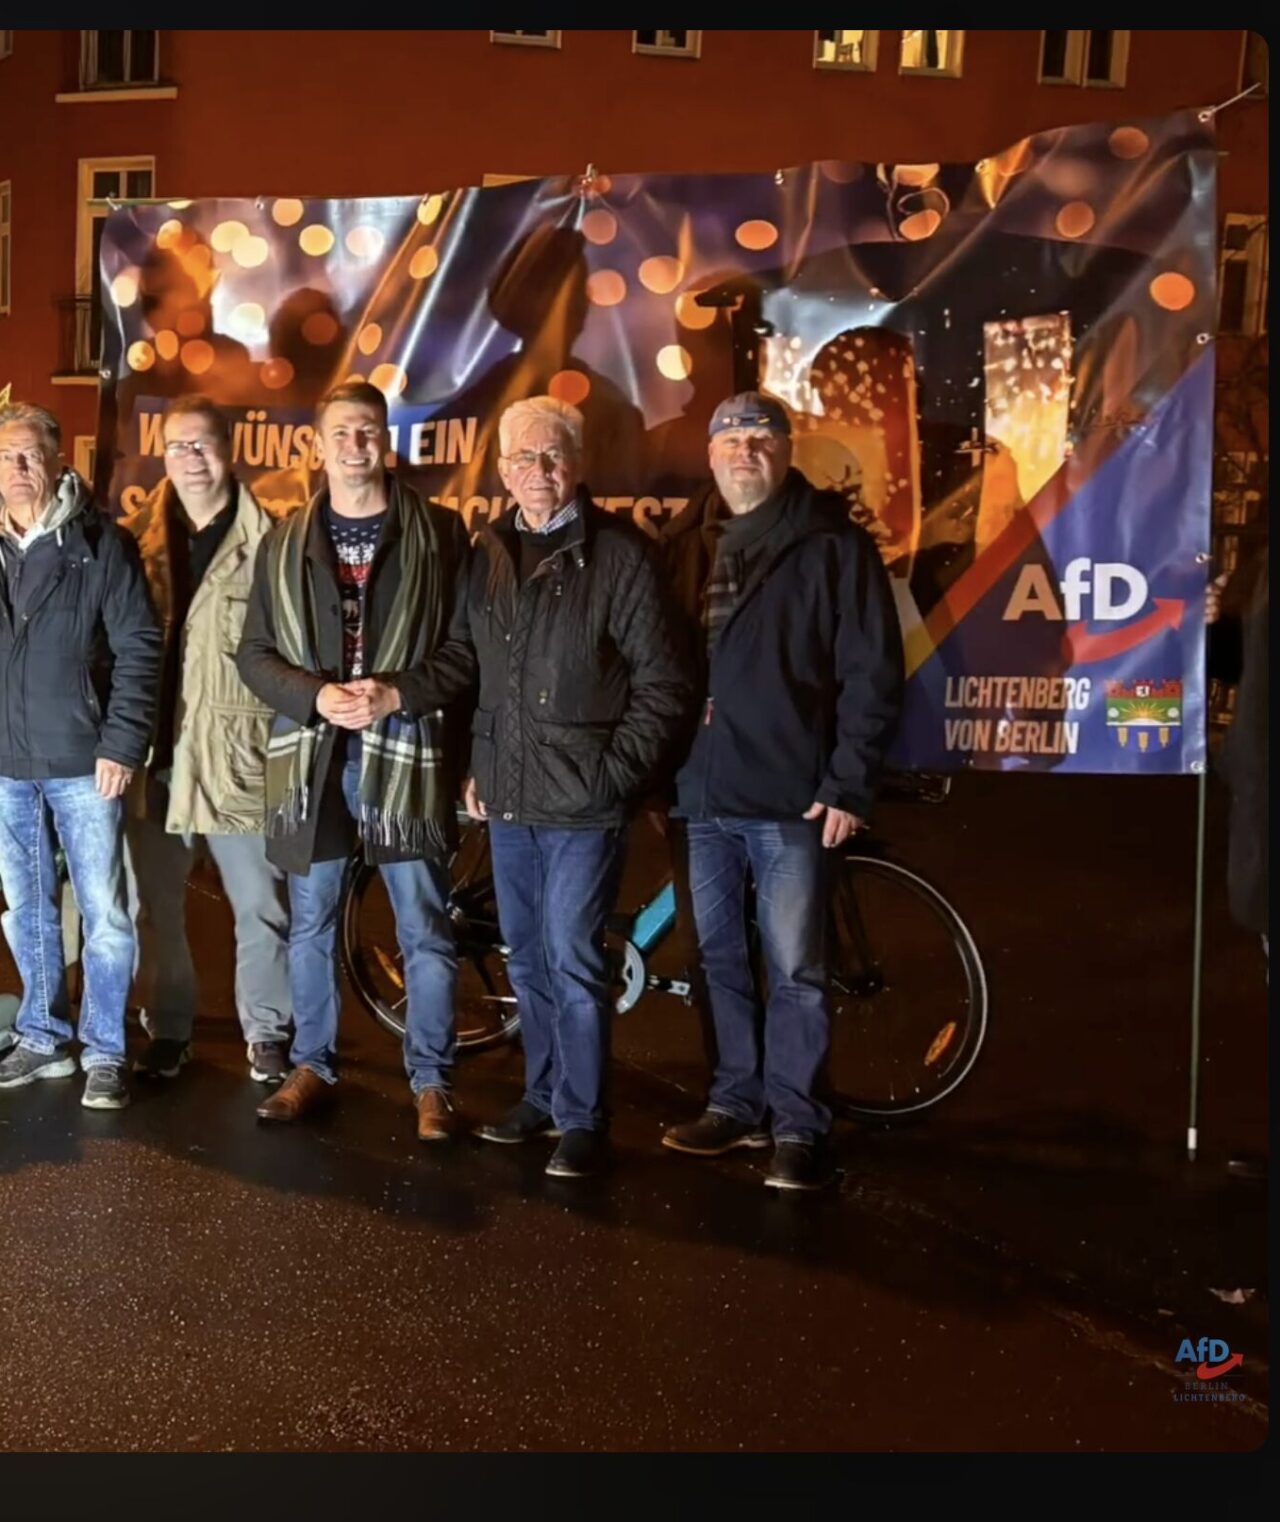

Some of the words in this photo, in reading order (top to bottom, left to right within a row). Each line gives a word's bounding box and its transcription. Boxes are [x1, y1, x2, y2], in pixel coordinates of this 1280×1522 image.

[409, 416, 478, 466] EIN
[1002, 557, 1149, 621] AfD
[944, 676, 1090, 710] LICHTENBERG
[944, 719, 992, 751] VON
[997, 720, 1080, 754] BERLIN
